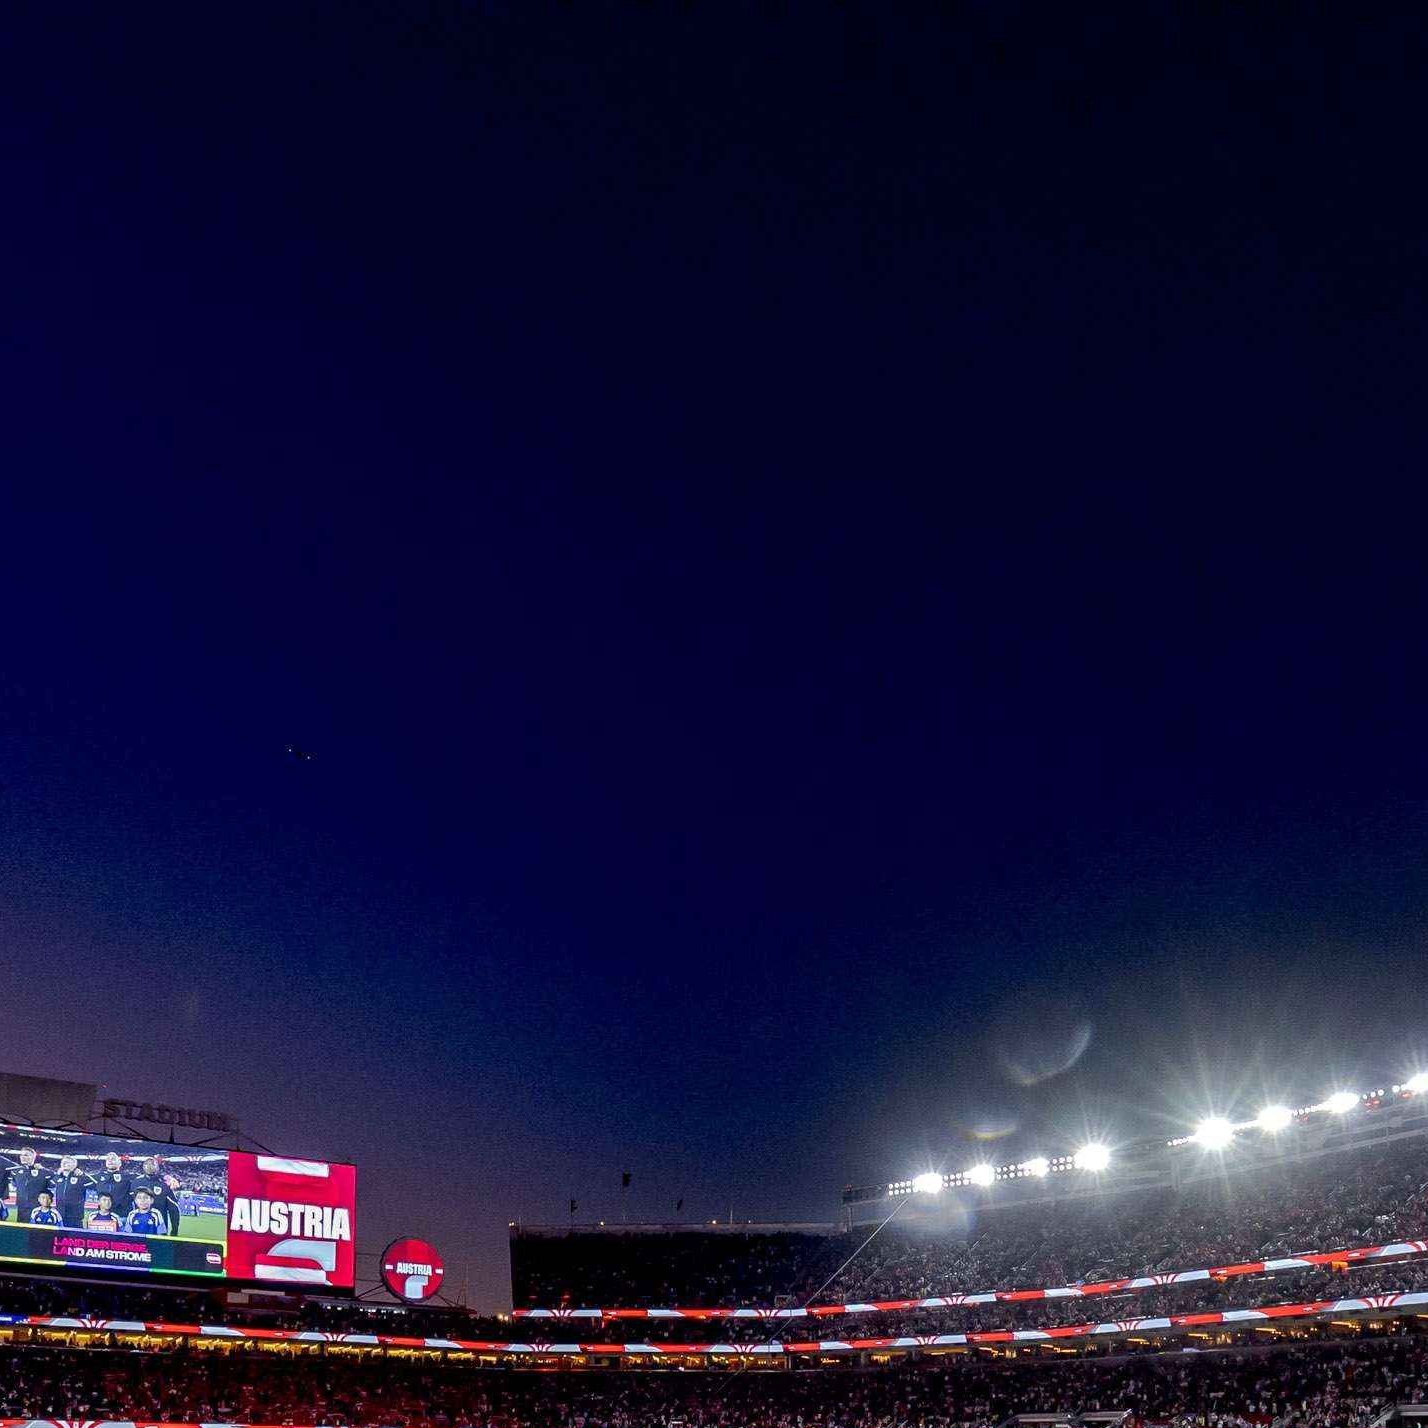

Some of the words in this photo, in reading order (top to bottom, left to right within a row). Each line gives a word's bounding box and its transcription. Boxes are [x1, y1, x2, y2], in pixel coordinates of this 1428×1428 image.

[103, 1098, 237, 1132] STADIUM
[230, 1197, 351, 1241] AUSTRIA
[53, 1246, 84, 1257] LAND
[85, 1248, 105, 1259] AM
[106, 1250, 151, 1262] STROME
[396, 1262, 432, 1276] AUSTRIA
